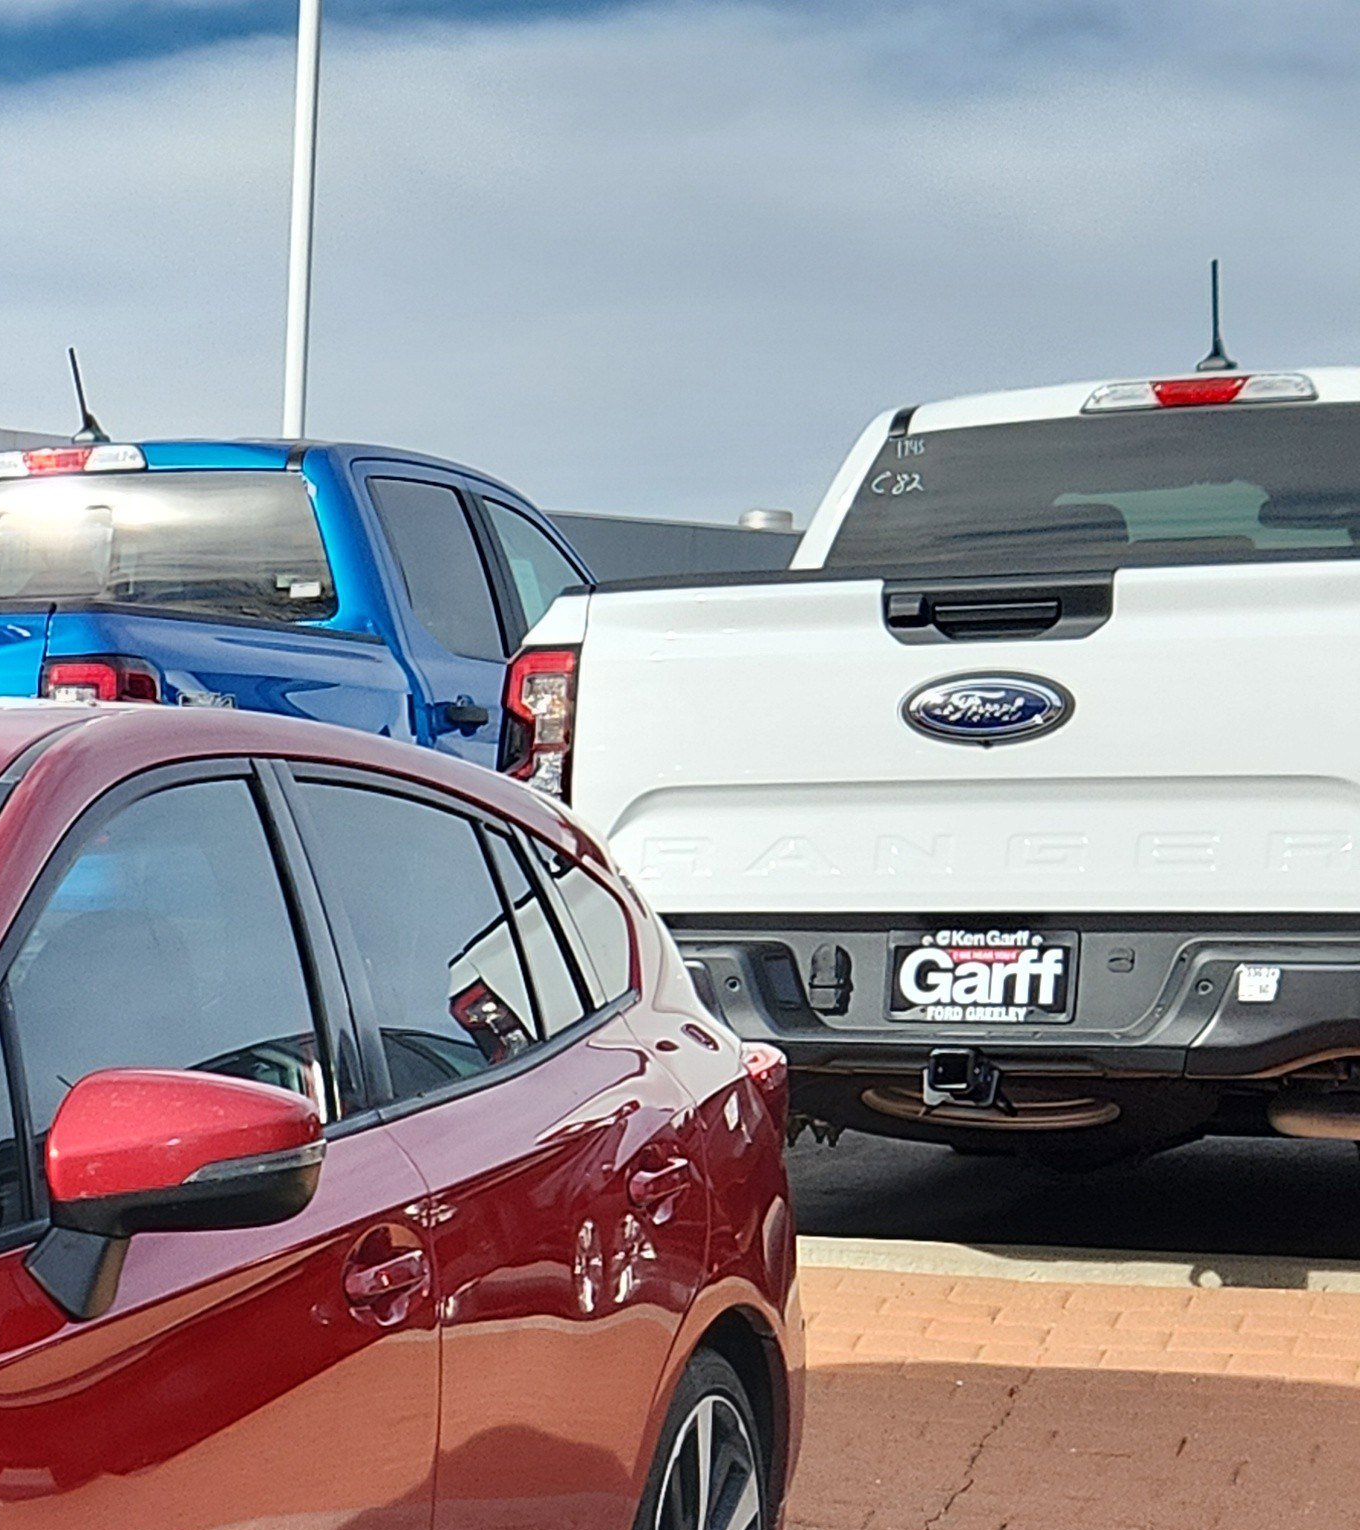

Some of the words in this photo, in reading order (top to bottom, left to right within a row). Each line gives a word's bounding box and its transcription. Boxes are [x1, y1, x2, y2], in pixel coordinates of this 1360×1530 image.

[871, 471, 924, 495] C82
[931, 690, 1026, 722] Ford
[638, 831, 1353, 880] RANGER
[951, 930, 985, 946] Ken
[986, 930, 1030, 946] Garff
[899, 947, 1064, 1005] Garff
[927, 1005, 963, 1021] FORD
[965, 1005, 1027, 1021] GREELEY
